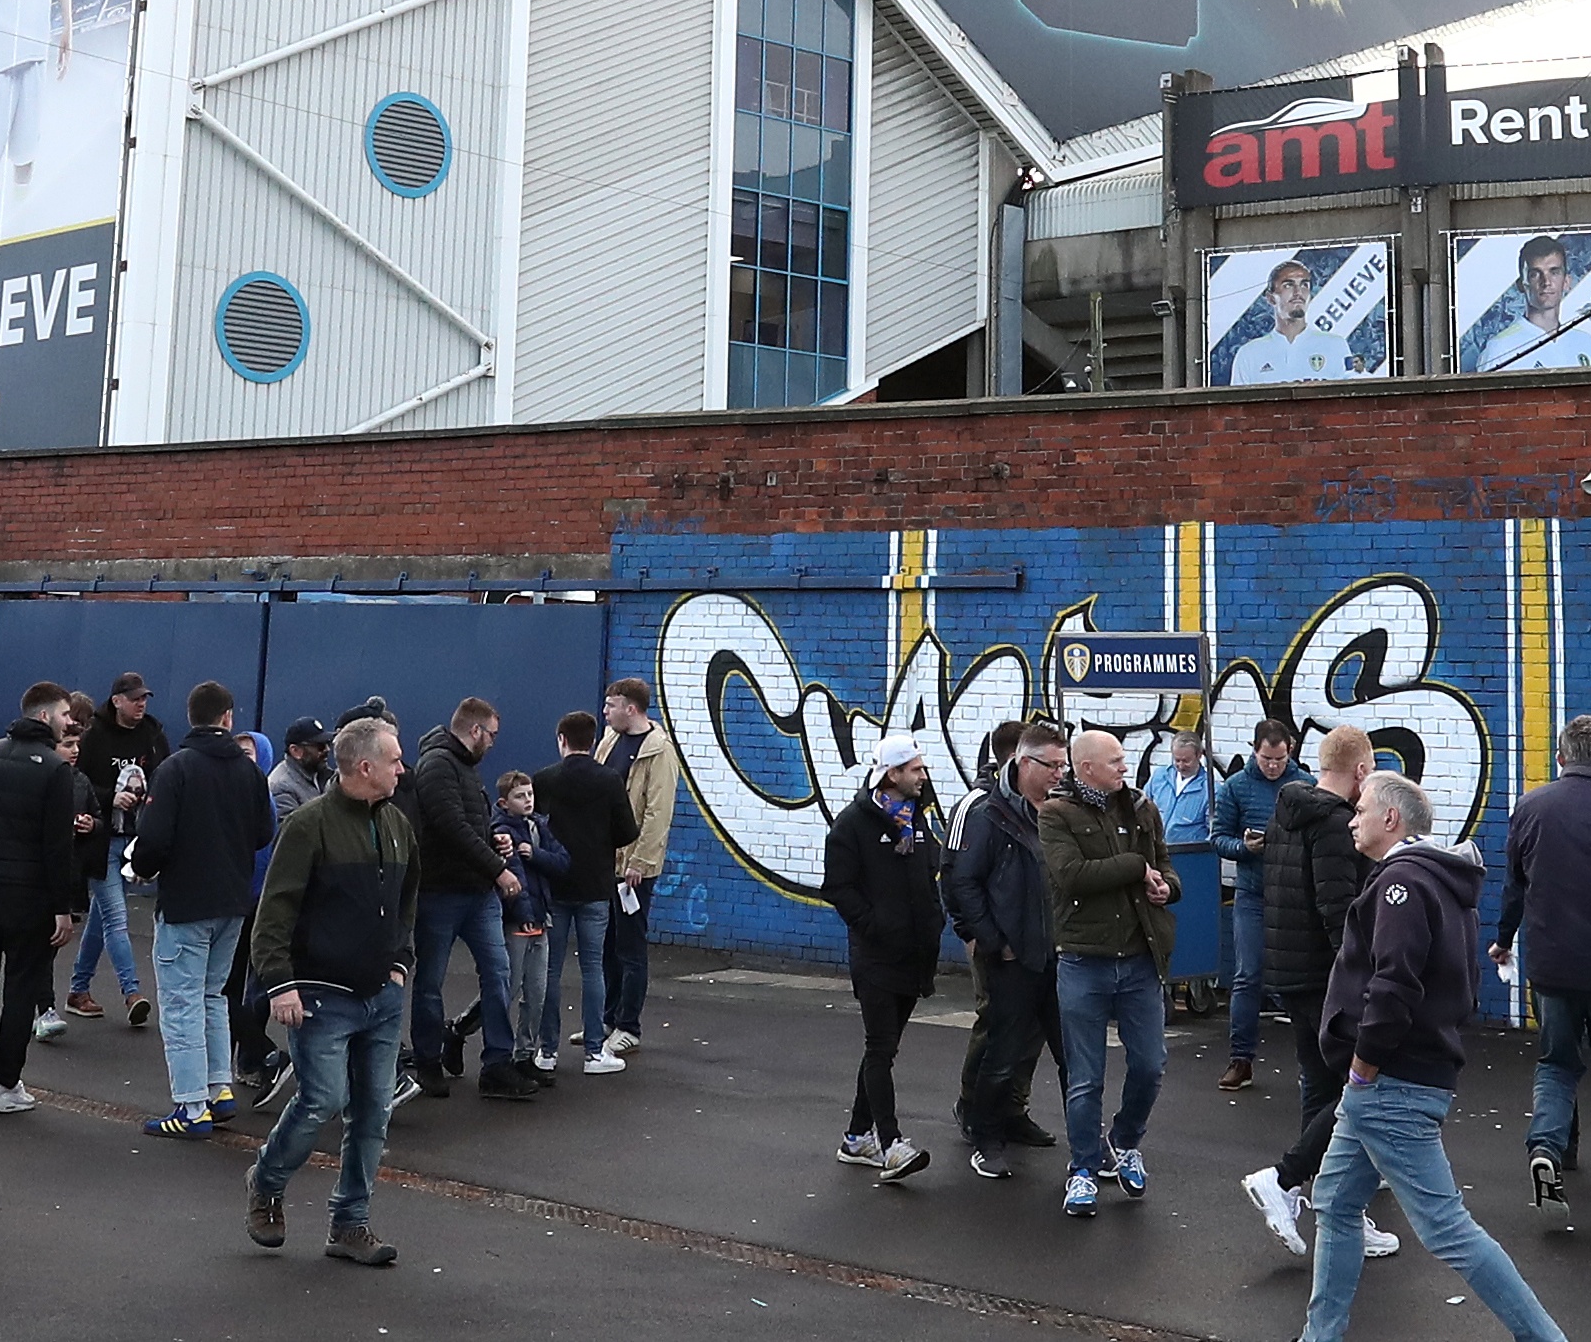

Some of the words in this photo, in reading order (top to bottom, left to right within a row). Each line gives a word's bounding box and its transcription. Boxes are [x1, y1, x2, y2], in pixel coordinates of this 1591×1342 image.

[1203, 100, 1397, 190] amt
[1450, 94, 1591, 146] Rent
[1313, 253, 1387, 334] BELIEVE
[1094, 653, 1198, 674] PROGRAMMES
